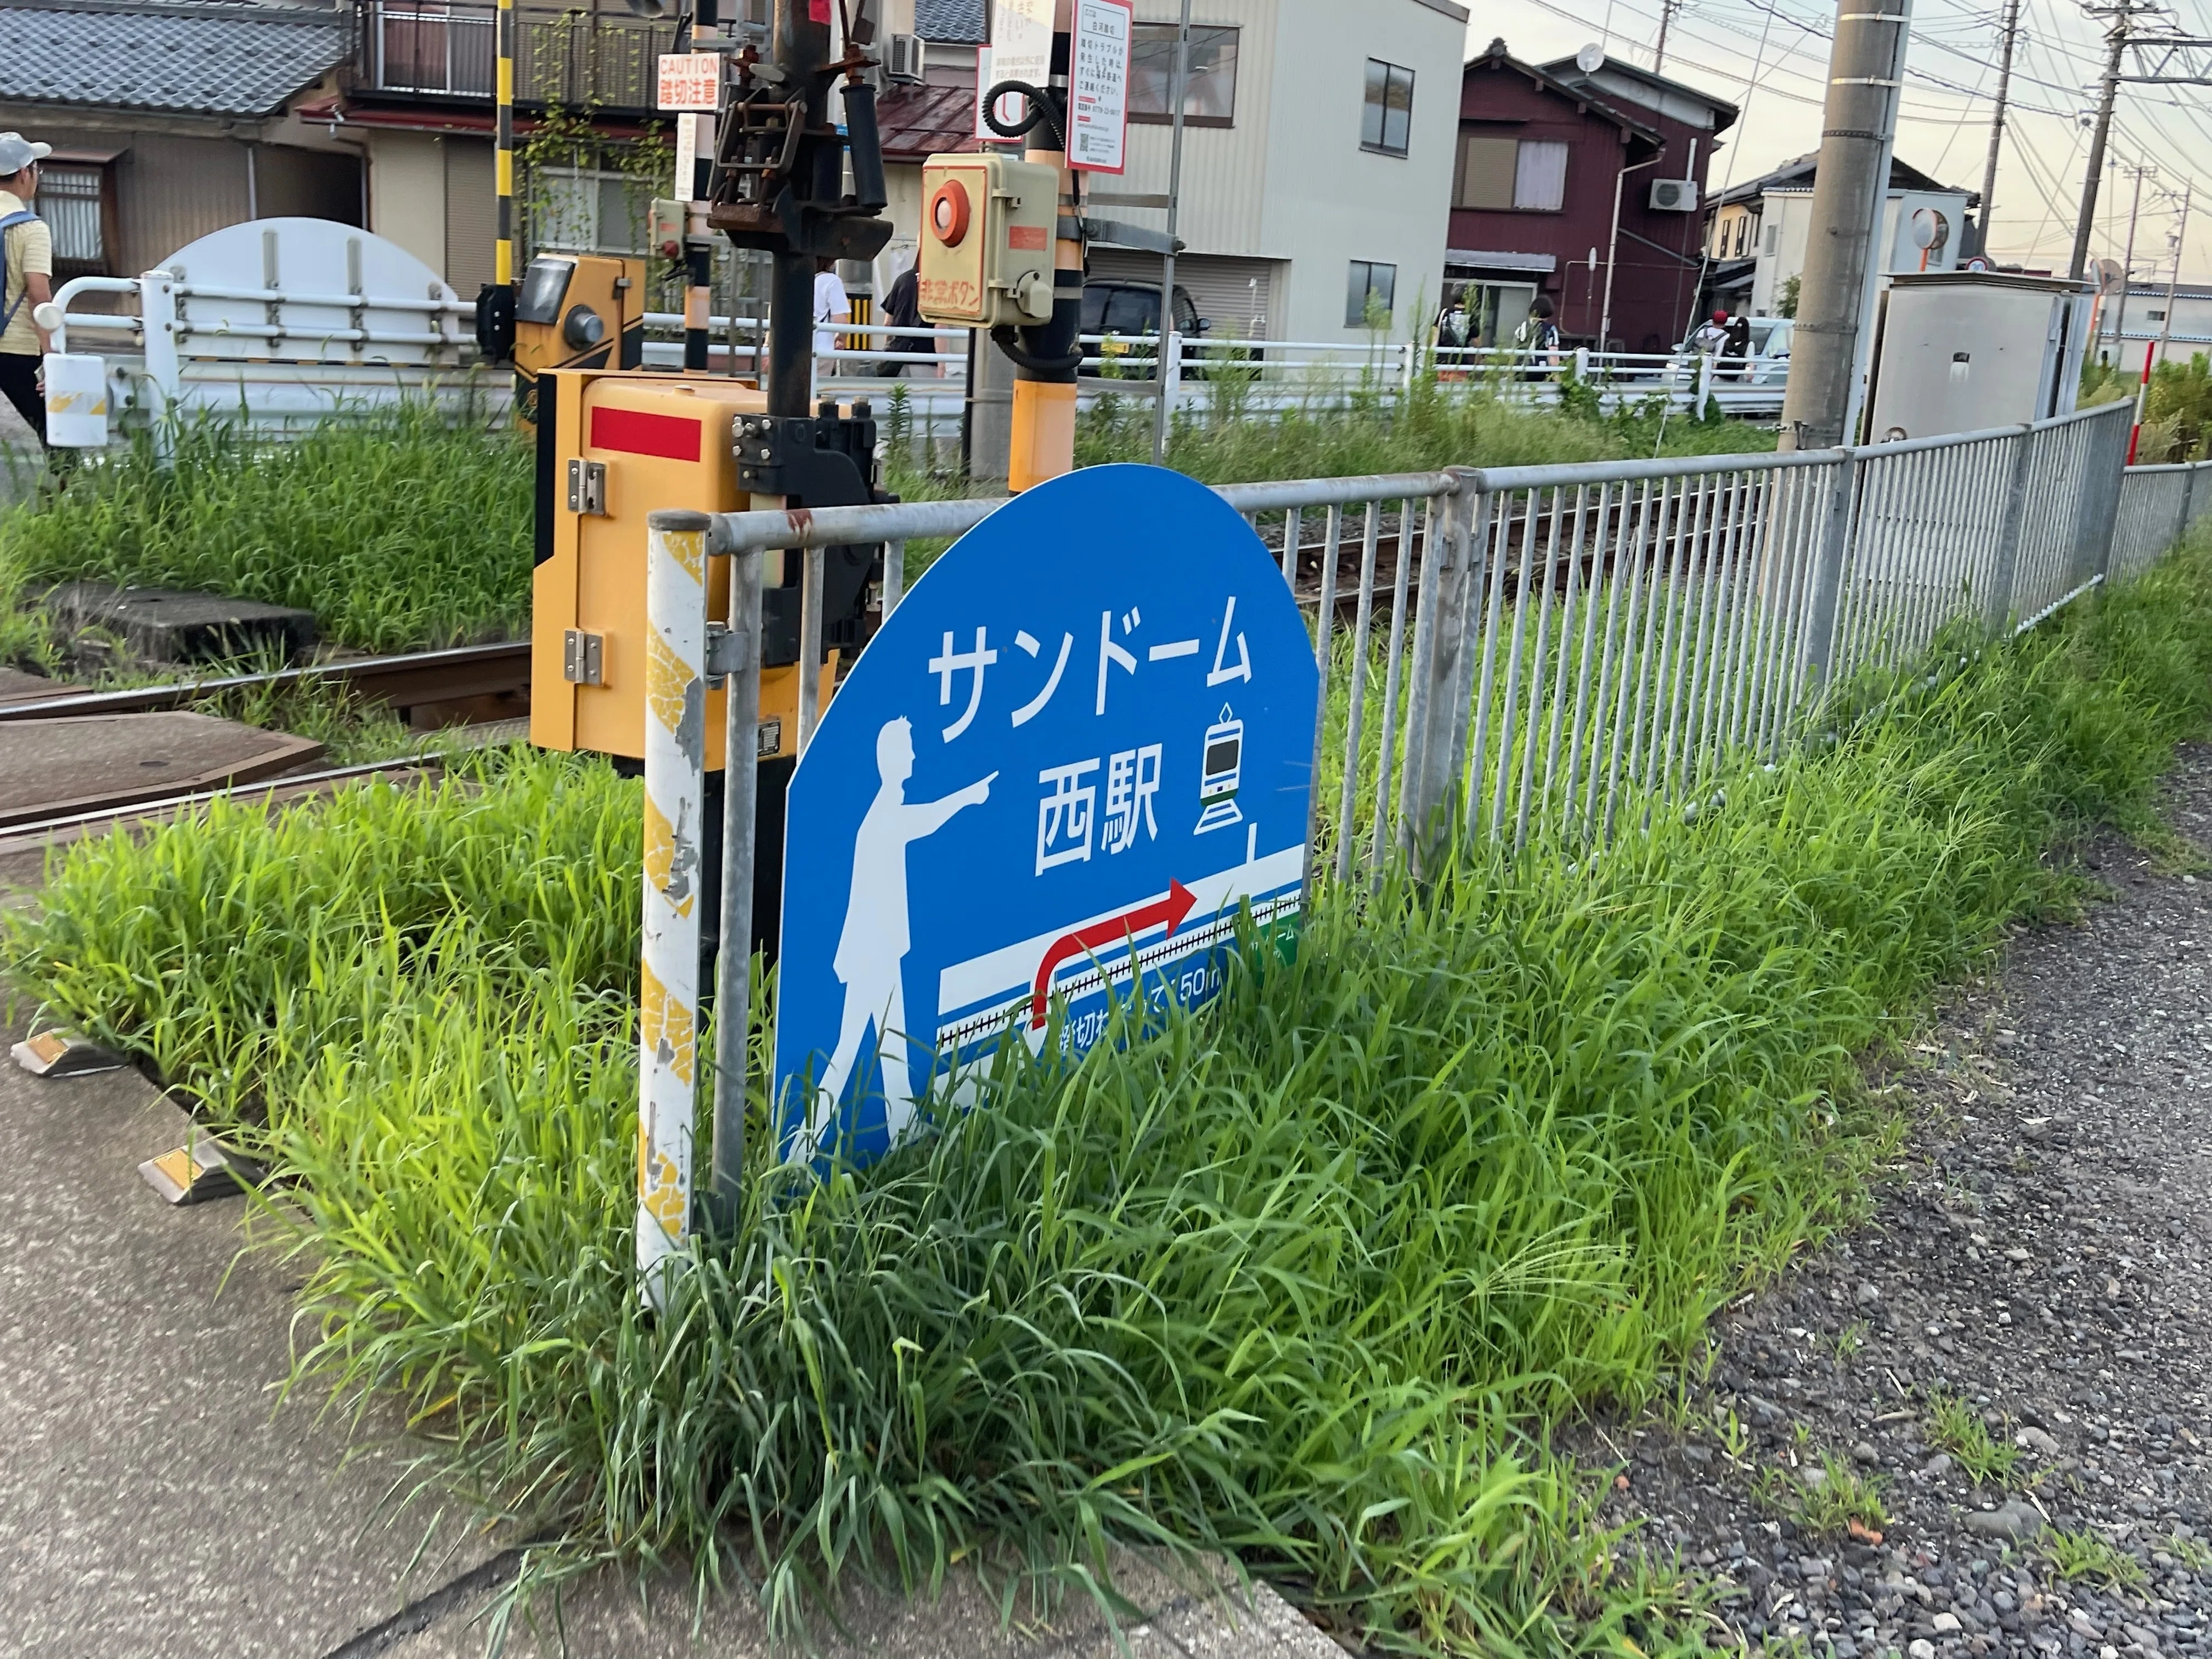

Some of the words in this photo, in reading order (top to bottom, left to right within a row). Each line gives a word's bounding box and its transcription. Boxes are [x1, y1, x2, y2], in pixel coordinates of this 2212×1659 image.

[660, 58, 718, 75] CAUTION
[659, 78, 716, 104] 踏切注意
[921, 278, 979, 307] 非常ボタン
[928, 595, 1252, 743] サンドーム
[1035, 743, 1163, 877] 西駅
